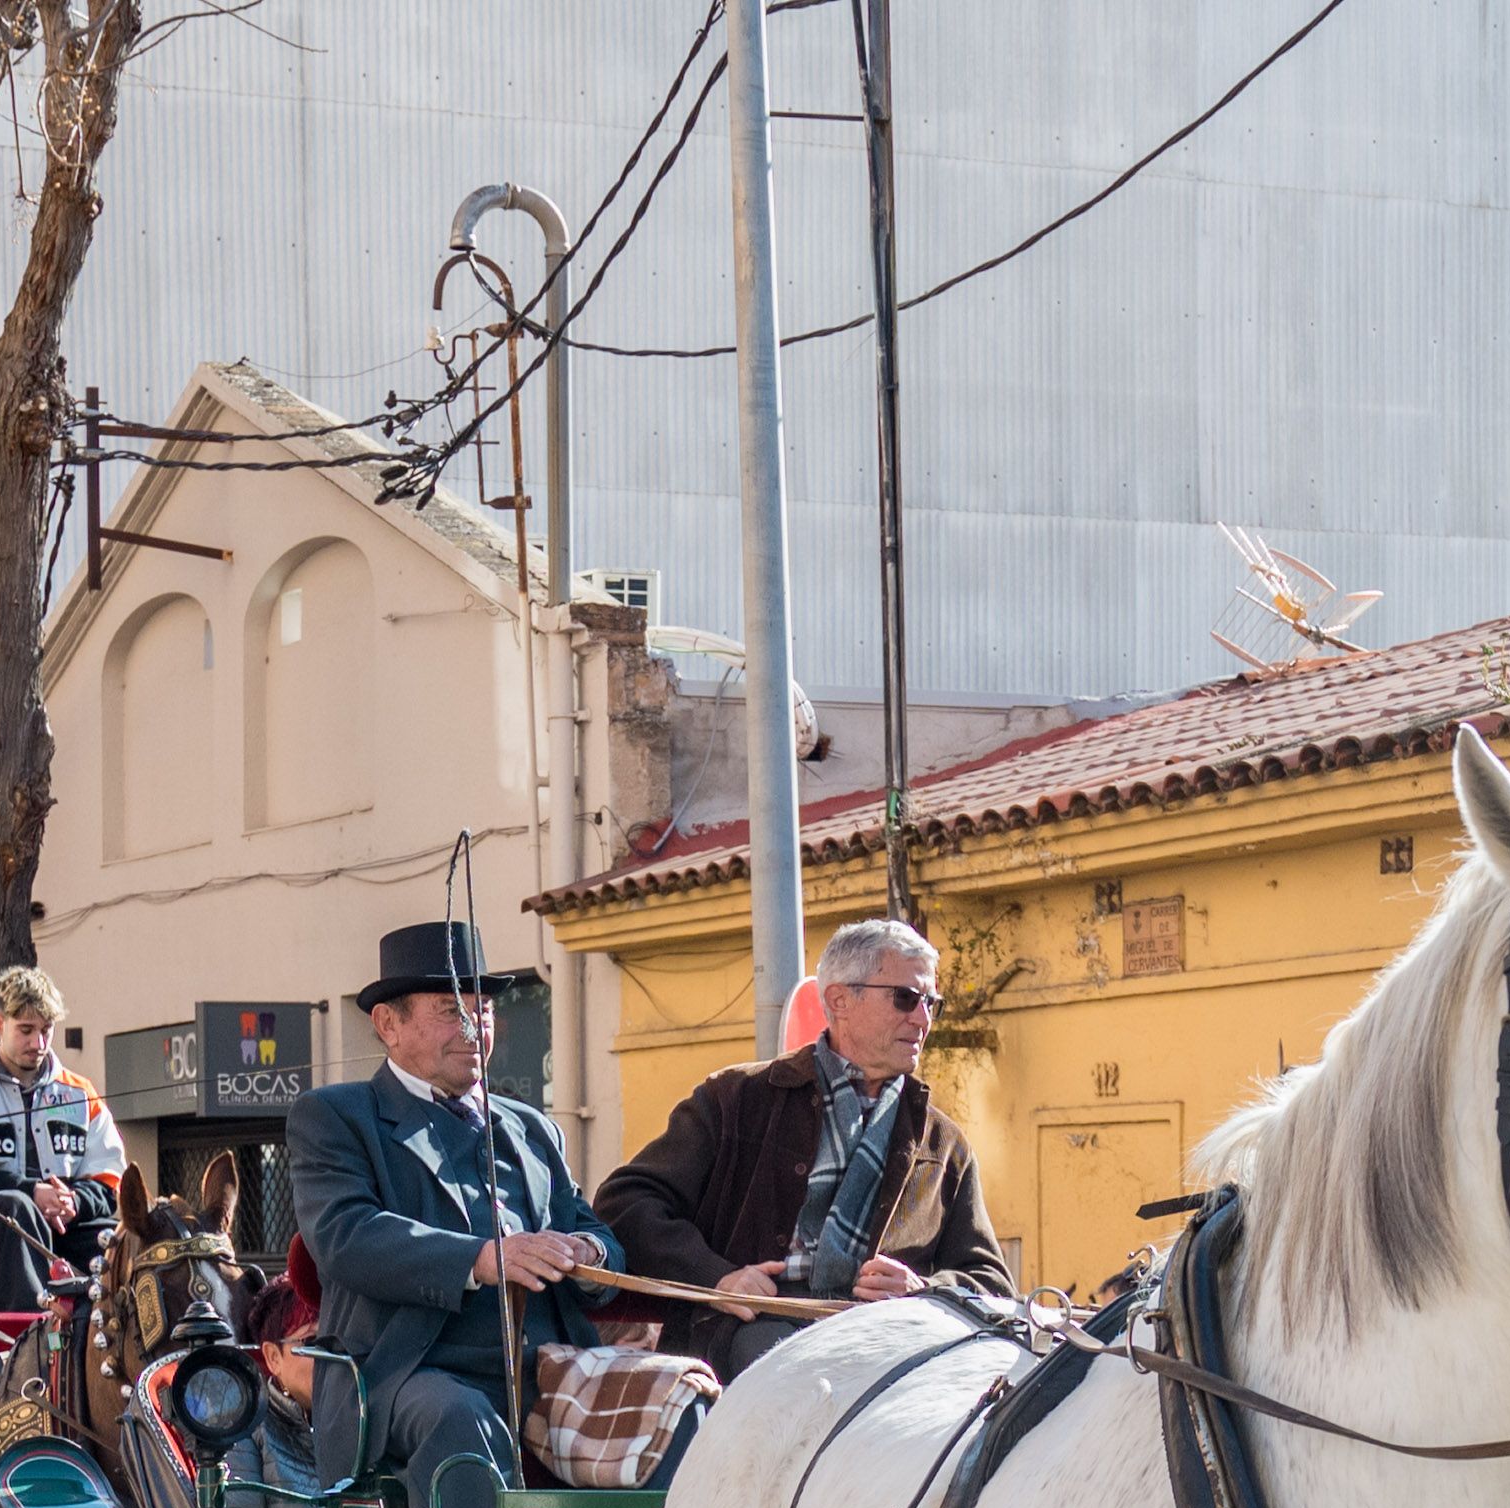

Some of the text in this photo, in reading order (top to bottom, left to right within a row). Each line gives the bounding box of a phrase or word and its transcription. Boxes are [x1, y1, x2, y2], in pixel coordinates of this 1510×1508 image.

[1151, 902, 1179, 917] CARRER
[1159, 921, 1169, 933] DE
[1163, 940, 1174, 951] DE
[1128, 955, 1180, 972] CERVANTES
[217, 1073, 300, 1095] BOCAS
[1092, 1062, 1119, 1097] 112
